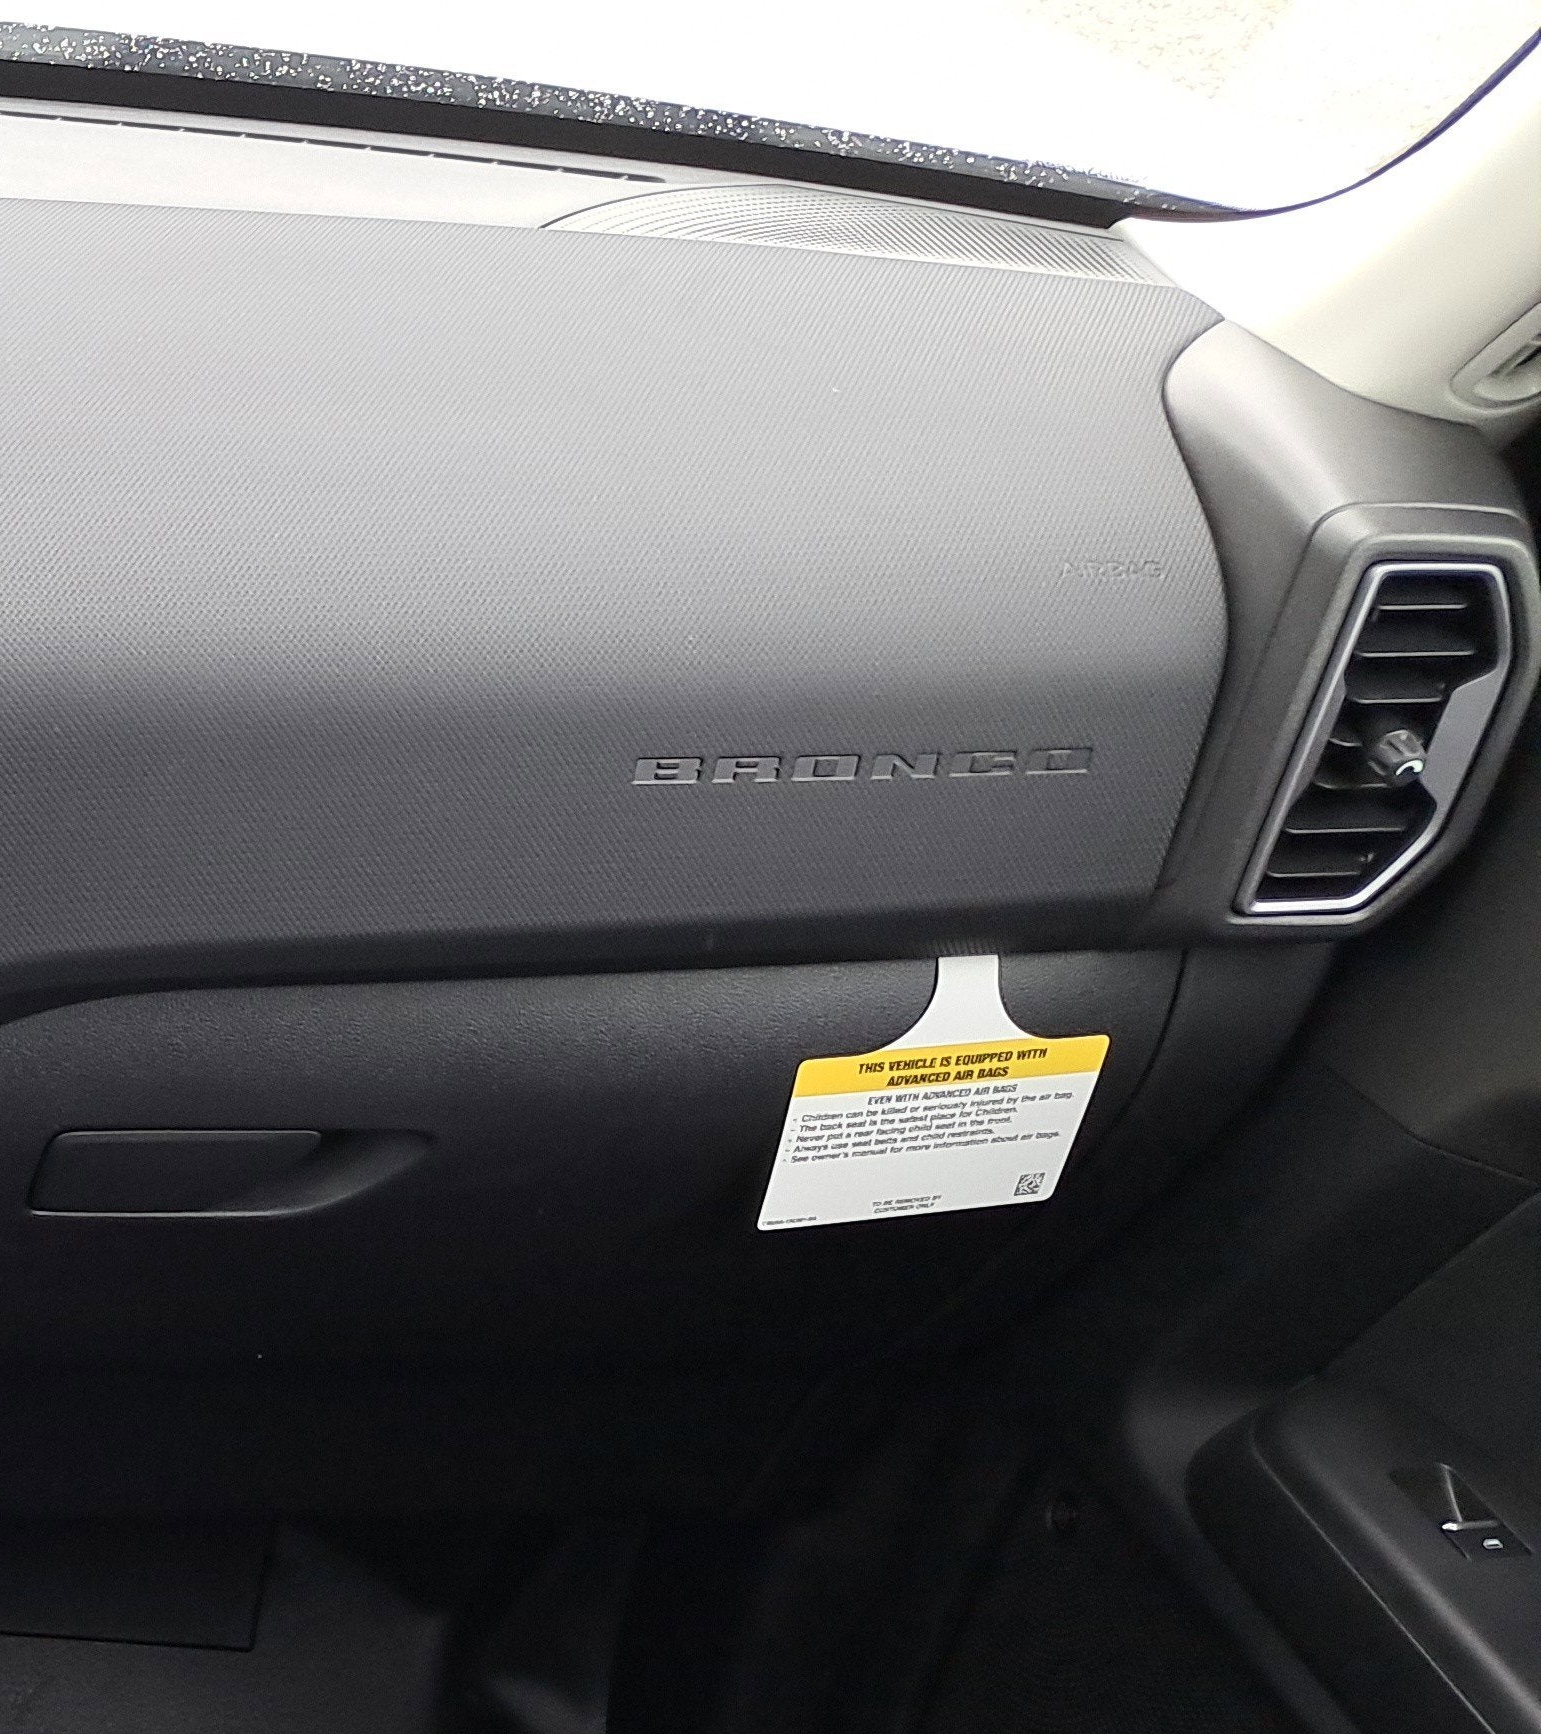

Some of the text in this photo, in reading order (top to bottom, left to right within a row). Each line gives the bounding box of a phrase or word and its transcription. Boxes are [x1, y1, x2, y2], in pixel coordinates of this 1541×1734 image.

[631, 747, 1093, 785] BRONCO
[859, 1048, 1047, 1074] THIS VEHICLE IS EQUIPPED WITH
[886, 1066, 1009, 1086] ADVANCED AIR BAGS
[868, 1084, 1018, 1105] EVEN WITH ADVANCED AIR BAGS
[802, 1112, 843, 1122] Children
[846, 1111, 863, 1119] can
[866, 1109, 878, 1117] be
[881, 1106, 907, 1116] killed
[923, 1101, 967, 1113] seriously
[970, 1097, 1004, 1108] injured
[1006, 1096, 1019, 1105] by
[1021, 1094, 1036, 1103] the
[800, 1124, 817, 1133] The
[820, 1121, 842, 1131] back
[846, 1120, 867, 1129] seat
[880, 1117, 895, 1125] the
[930, 1112, 956, 1124] place
[959, 1109, 972, 1118] for
[796, 1134, 825, 1143] Never
[854, 1129, 874, 1138] rear
[793, 1143, 828, 1153] Always
